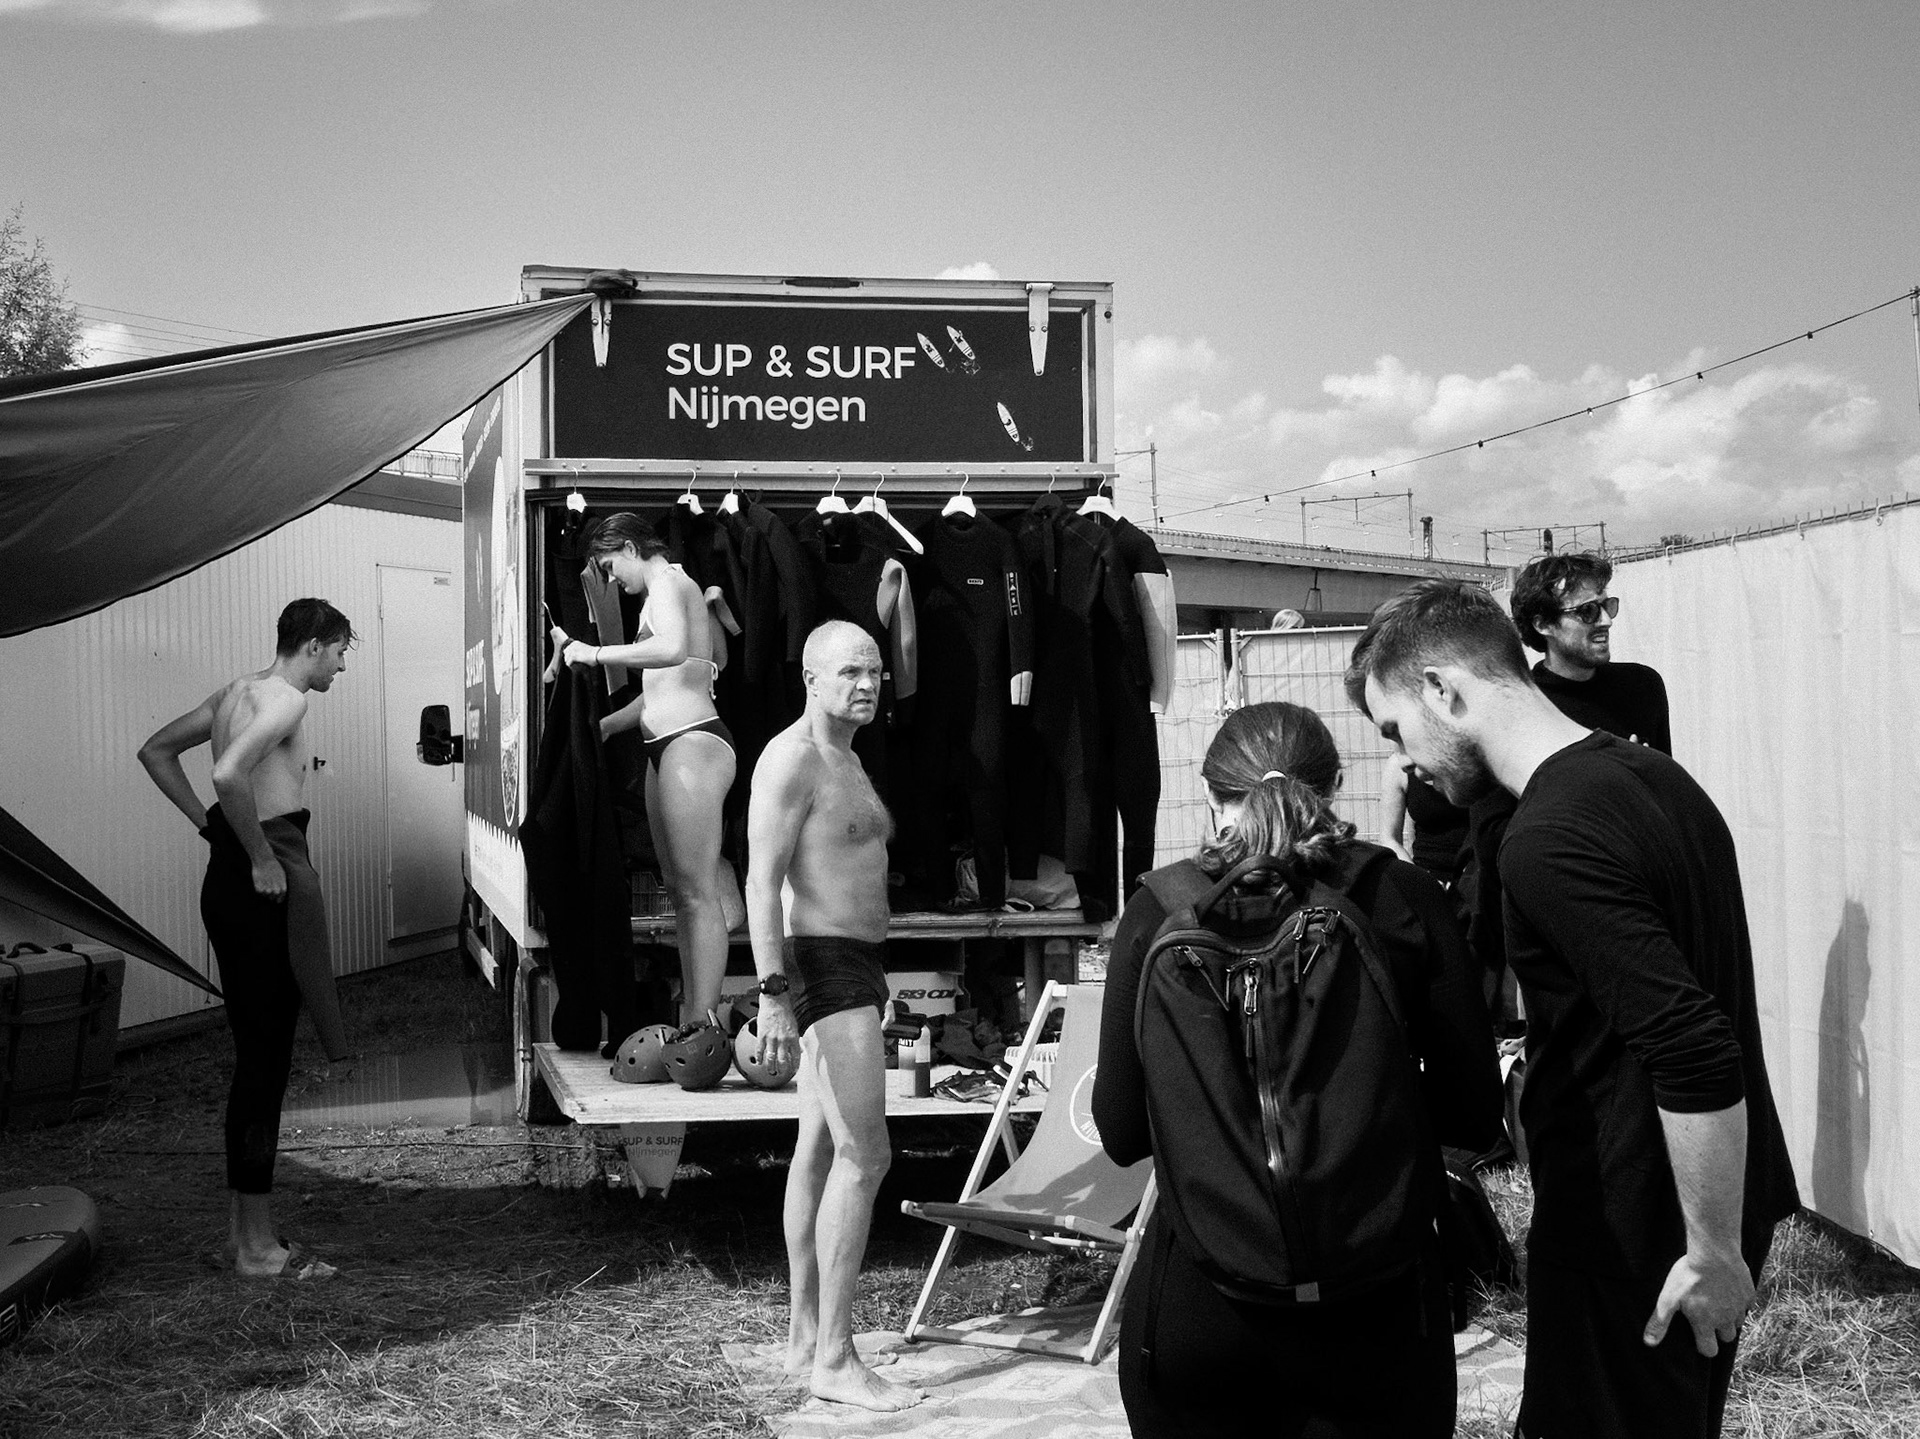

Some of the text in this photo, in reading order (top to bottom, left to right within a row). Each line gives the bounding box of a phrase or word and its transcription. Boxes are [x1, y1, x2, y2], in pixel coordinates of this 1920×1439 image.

[666, 343, 917, 379] SUP & SURF
[668, 385, 867, 430] Nijmegen
[623, 1136, 684, 1147] SUP & SURF
